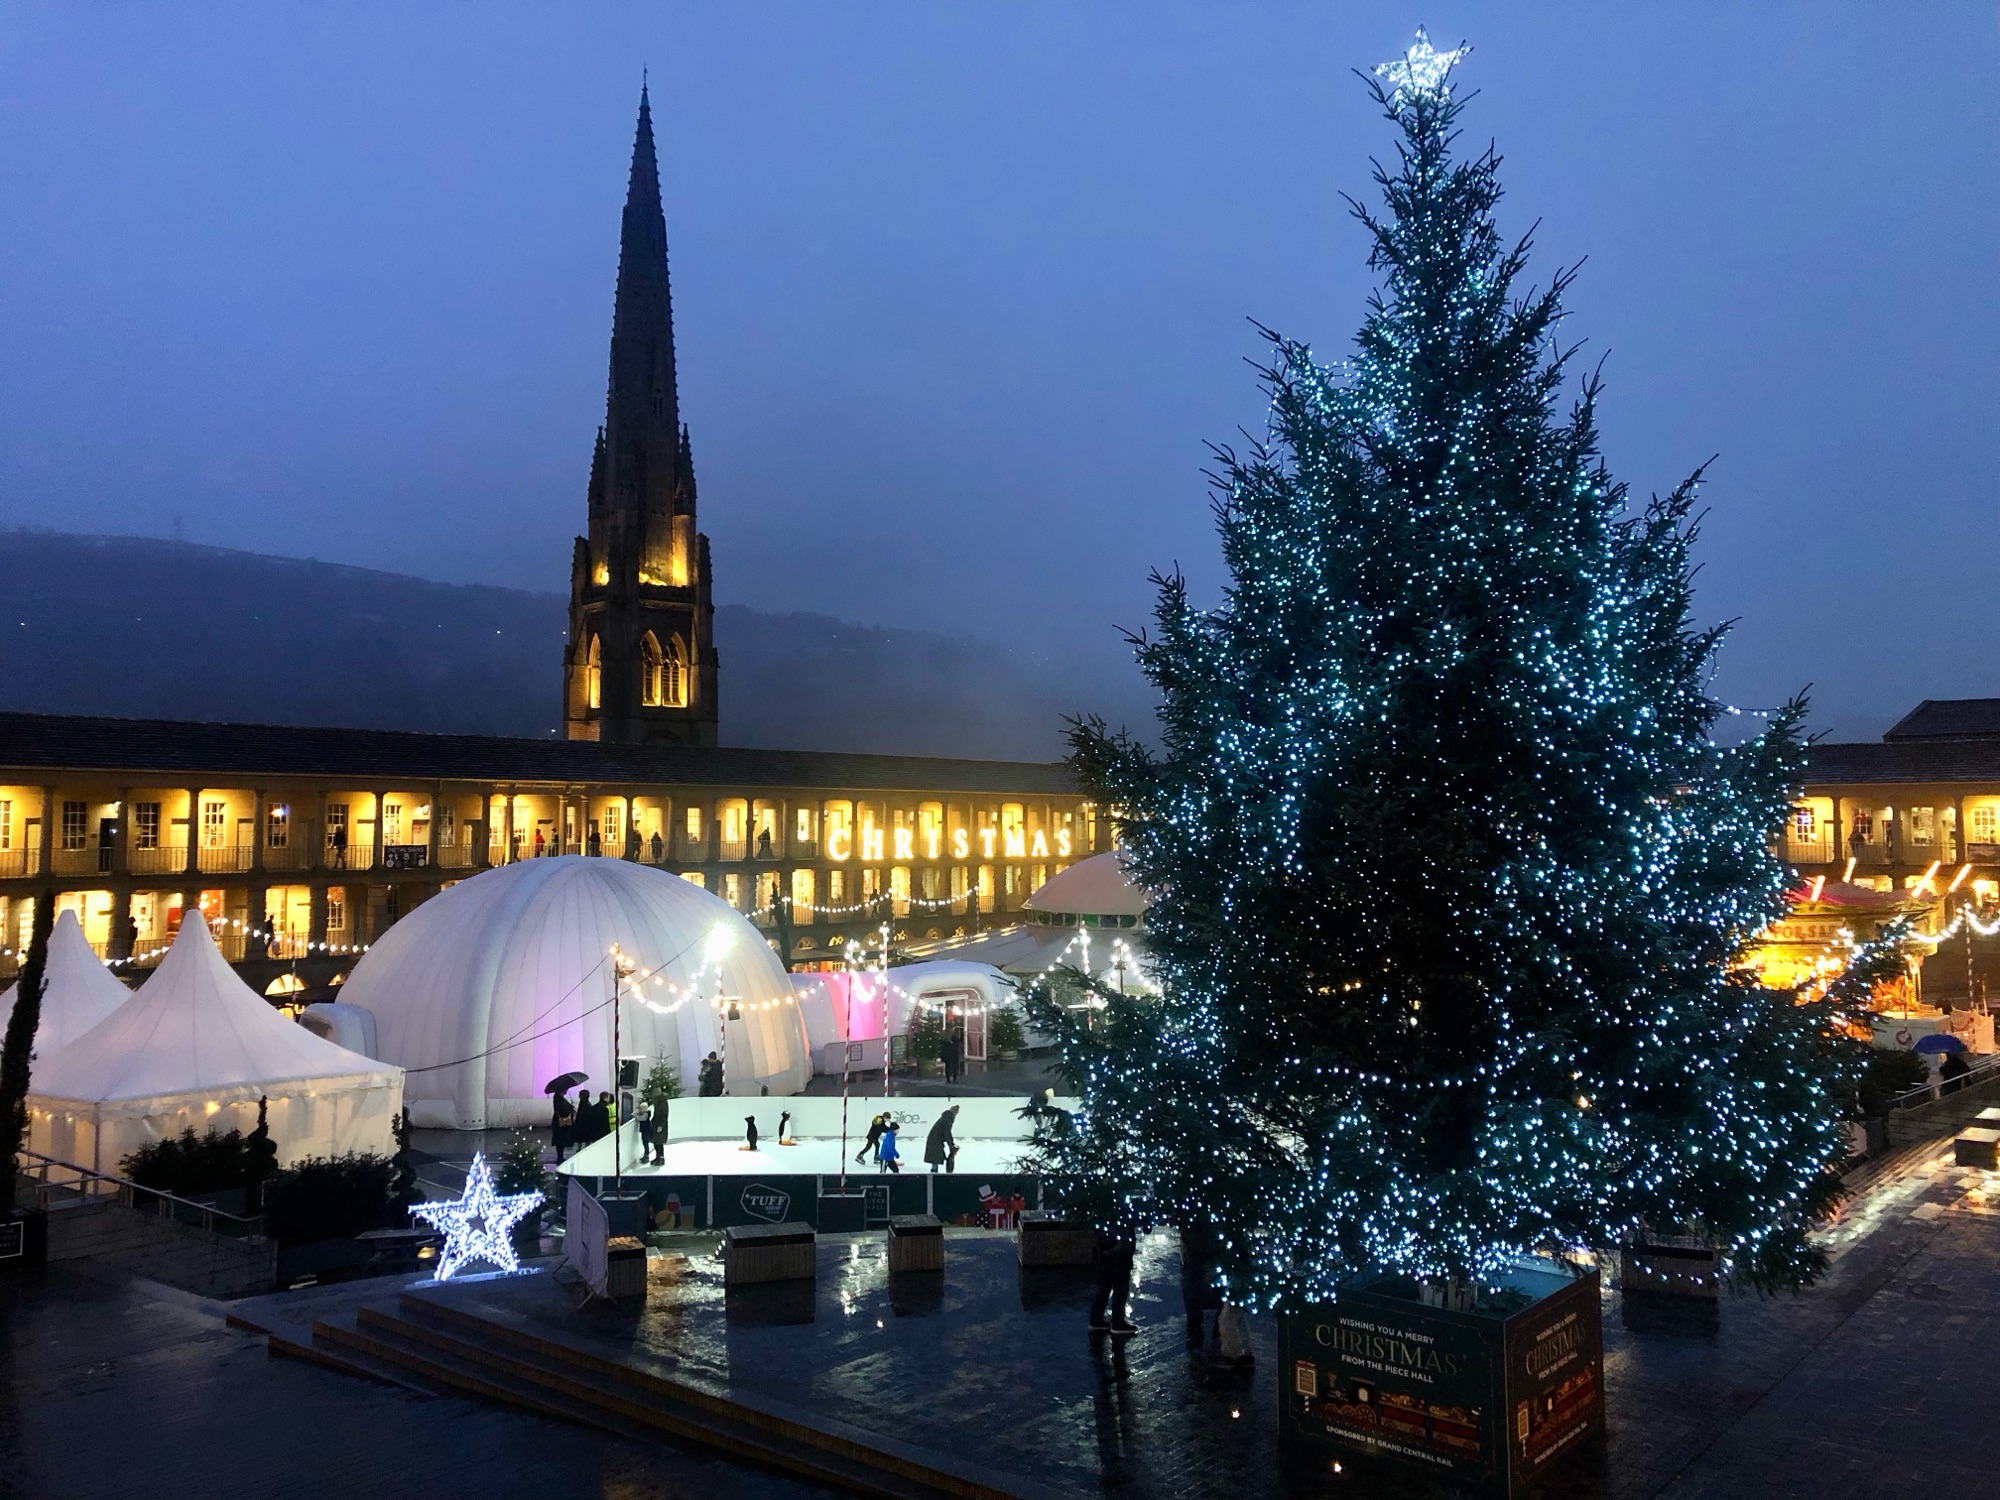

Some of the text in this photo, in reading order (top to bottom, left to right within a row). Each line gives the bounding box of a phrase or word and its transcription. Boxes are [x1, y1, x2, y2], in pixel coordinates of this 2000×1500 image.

[828, 827, 1069, 860] CHRISTMAS
[750, 1196, 787, 1206] TUFF
[1339, 1317, 1435, 1345] WISHING YOU A MERRY
[1315, 1324, 1458, 1377] CHRISTMAS
[1526, 1321, 1586, 1375] CHRISTMAS
[1341, 1354, 1435, 1384] FROM THE PIECE HALL
[1326, 1425, 1453, 1468] SPONSORED BY GRAND CENTRAL RAIL
